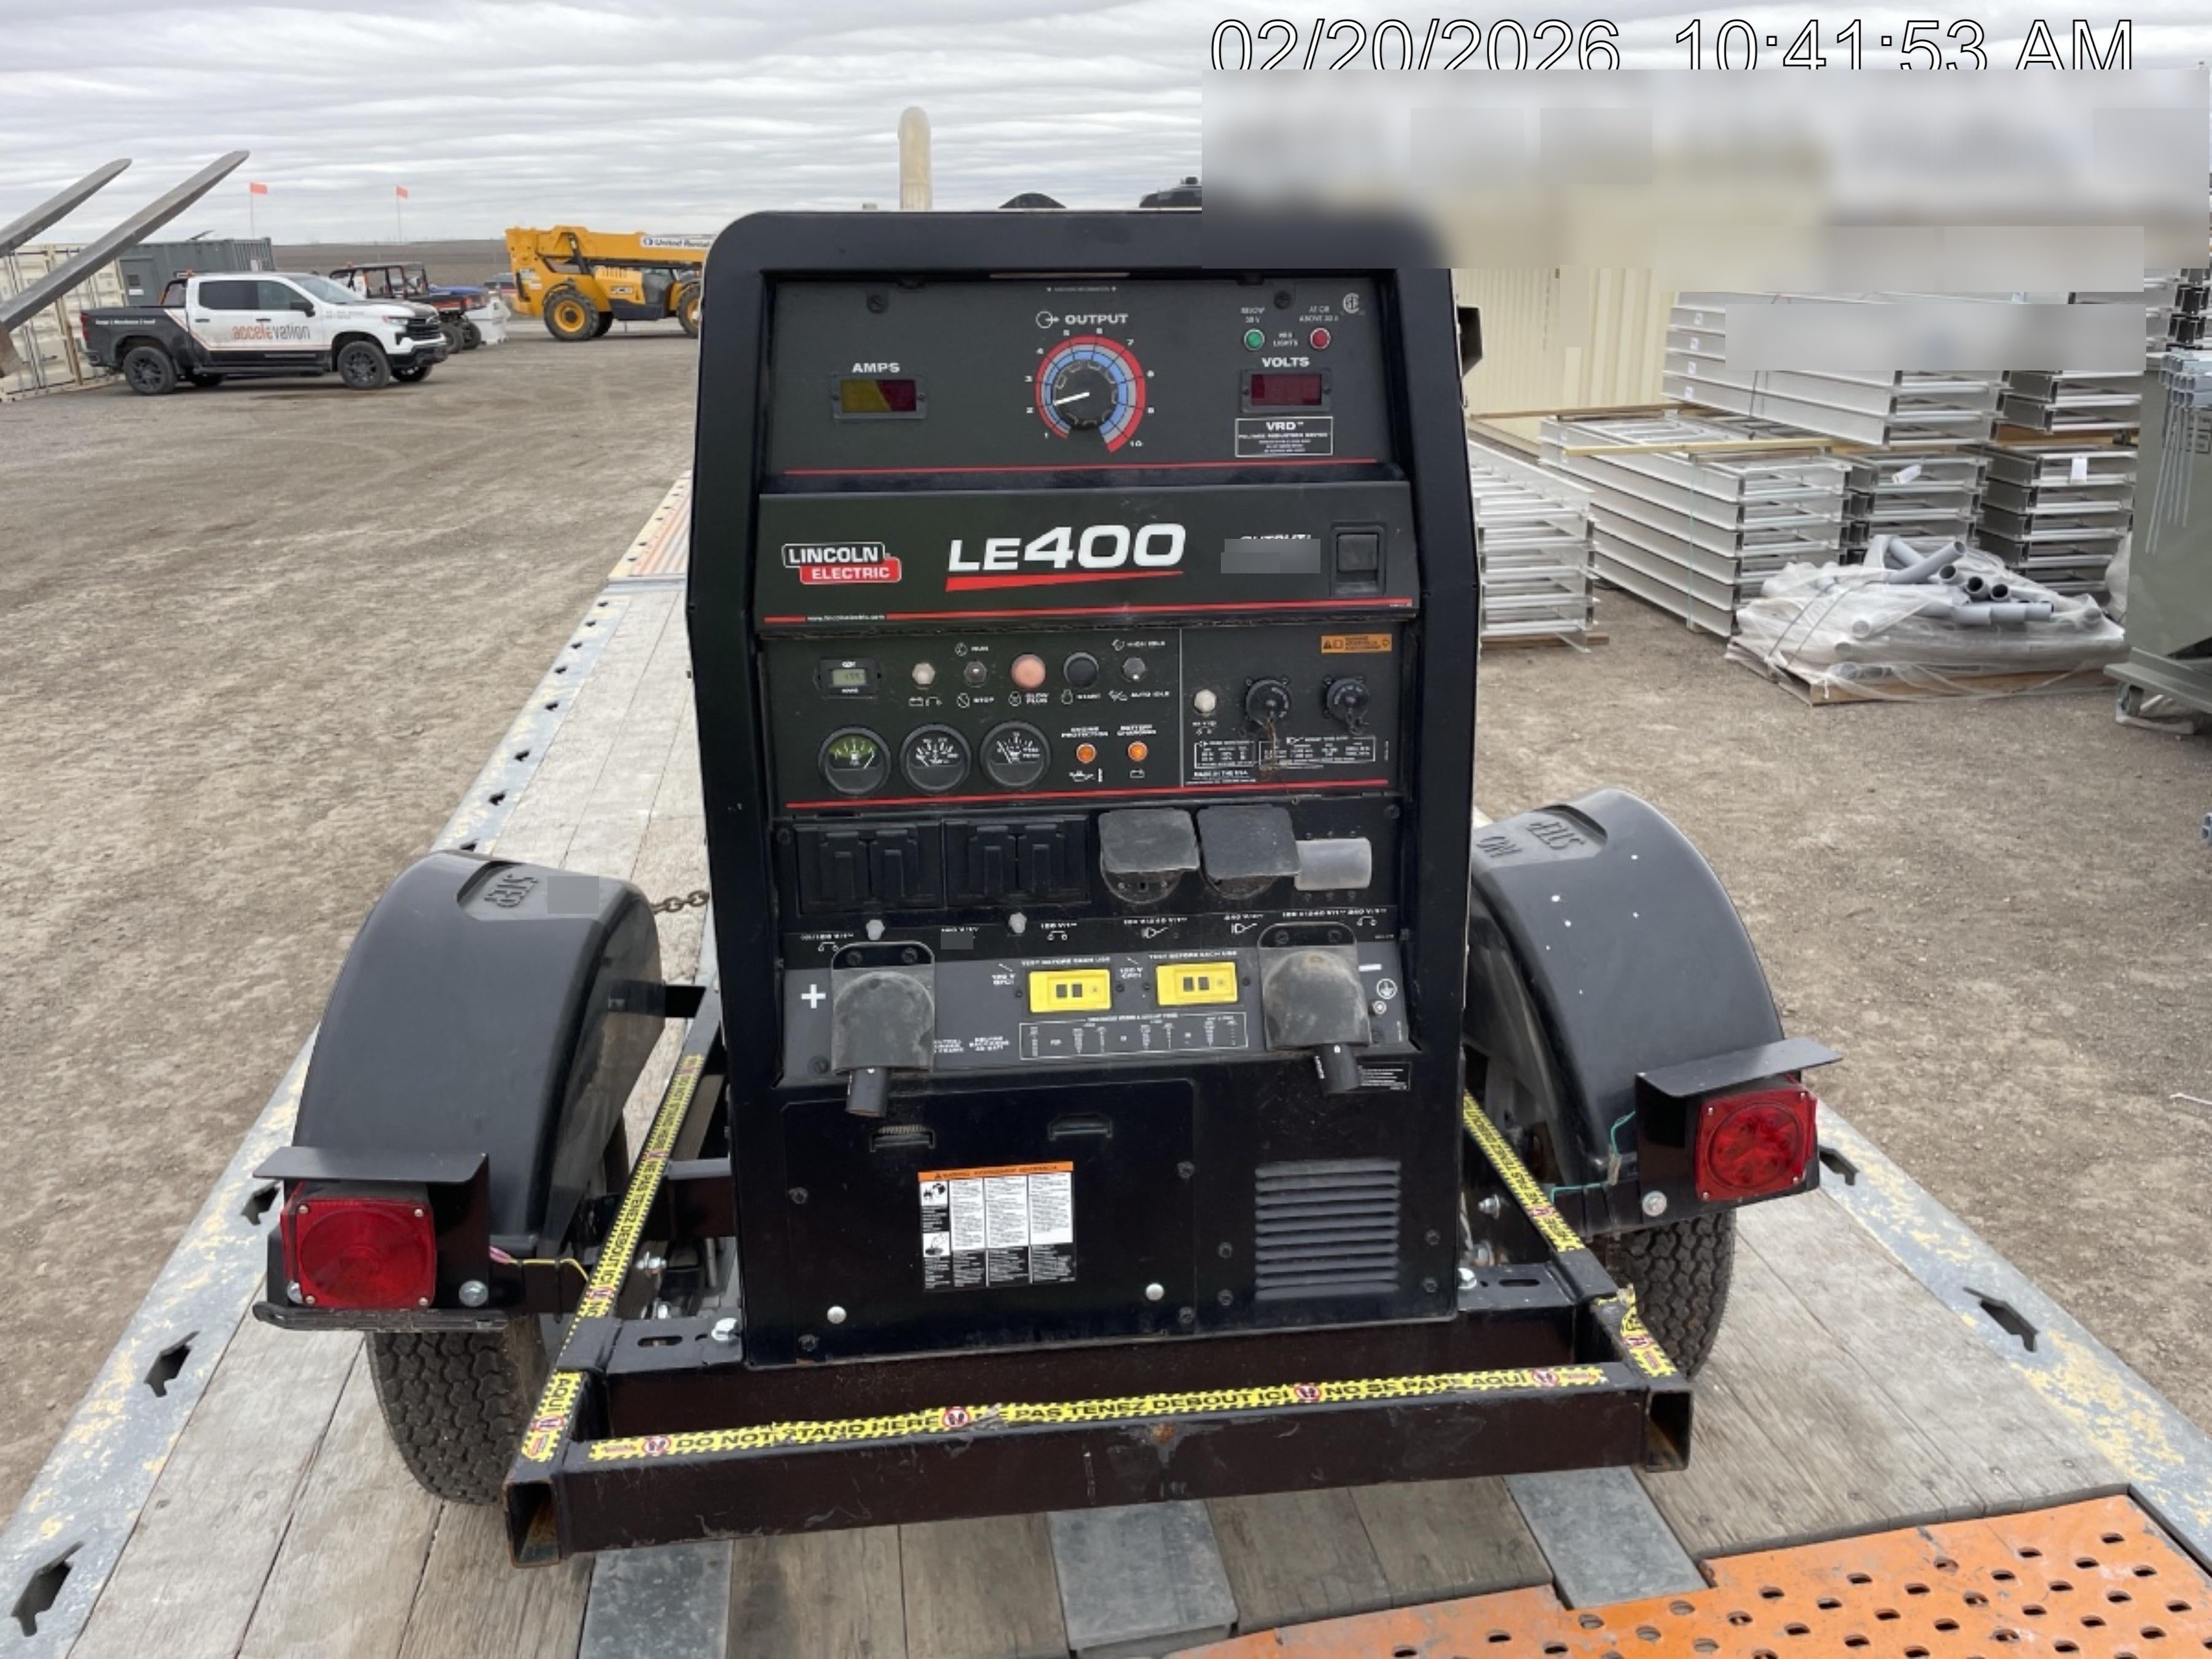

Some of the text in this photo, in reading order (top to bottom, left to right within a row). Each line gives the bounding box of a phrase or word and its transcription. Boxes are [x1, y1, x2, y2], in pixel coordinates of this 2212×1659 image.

[1064, 313, 1129, 326] OUTPUT
[852, 361, 901, 374] AMPS
[1261, 356, 1310, 368] VOLTS
[788, 546, 879, 564] LINCOLN
[946, 522, 1186, 572] LE400
[812, 567, 891, 580] ELECTRIC
[637, 1174, 653, 1191] PAS
[624, 1194, 646, 1224] TENEZ
[605, 1226, 633, 1268] DEBOUT
[600, 1269, 616, 1285] ICI
[677, 1437, 705, 1448] DO
[721, 1430, 771, 1445] NOT
[871, 1416, 941, 1432] HERE
[1015, 1407, 1063, 1419] PAS
[1071, 1401, 1147, 1416] TENEZ
[1152, 1392, 1256, 1410] DEBOUT
[1258, 1390, 1289, 1401] ICI
[1325, 1383, 1362, 1396] NO
[1366, 1381, 1398, 1392] SE
[1403, 1377, 1467, 1390] PARE
